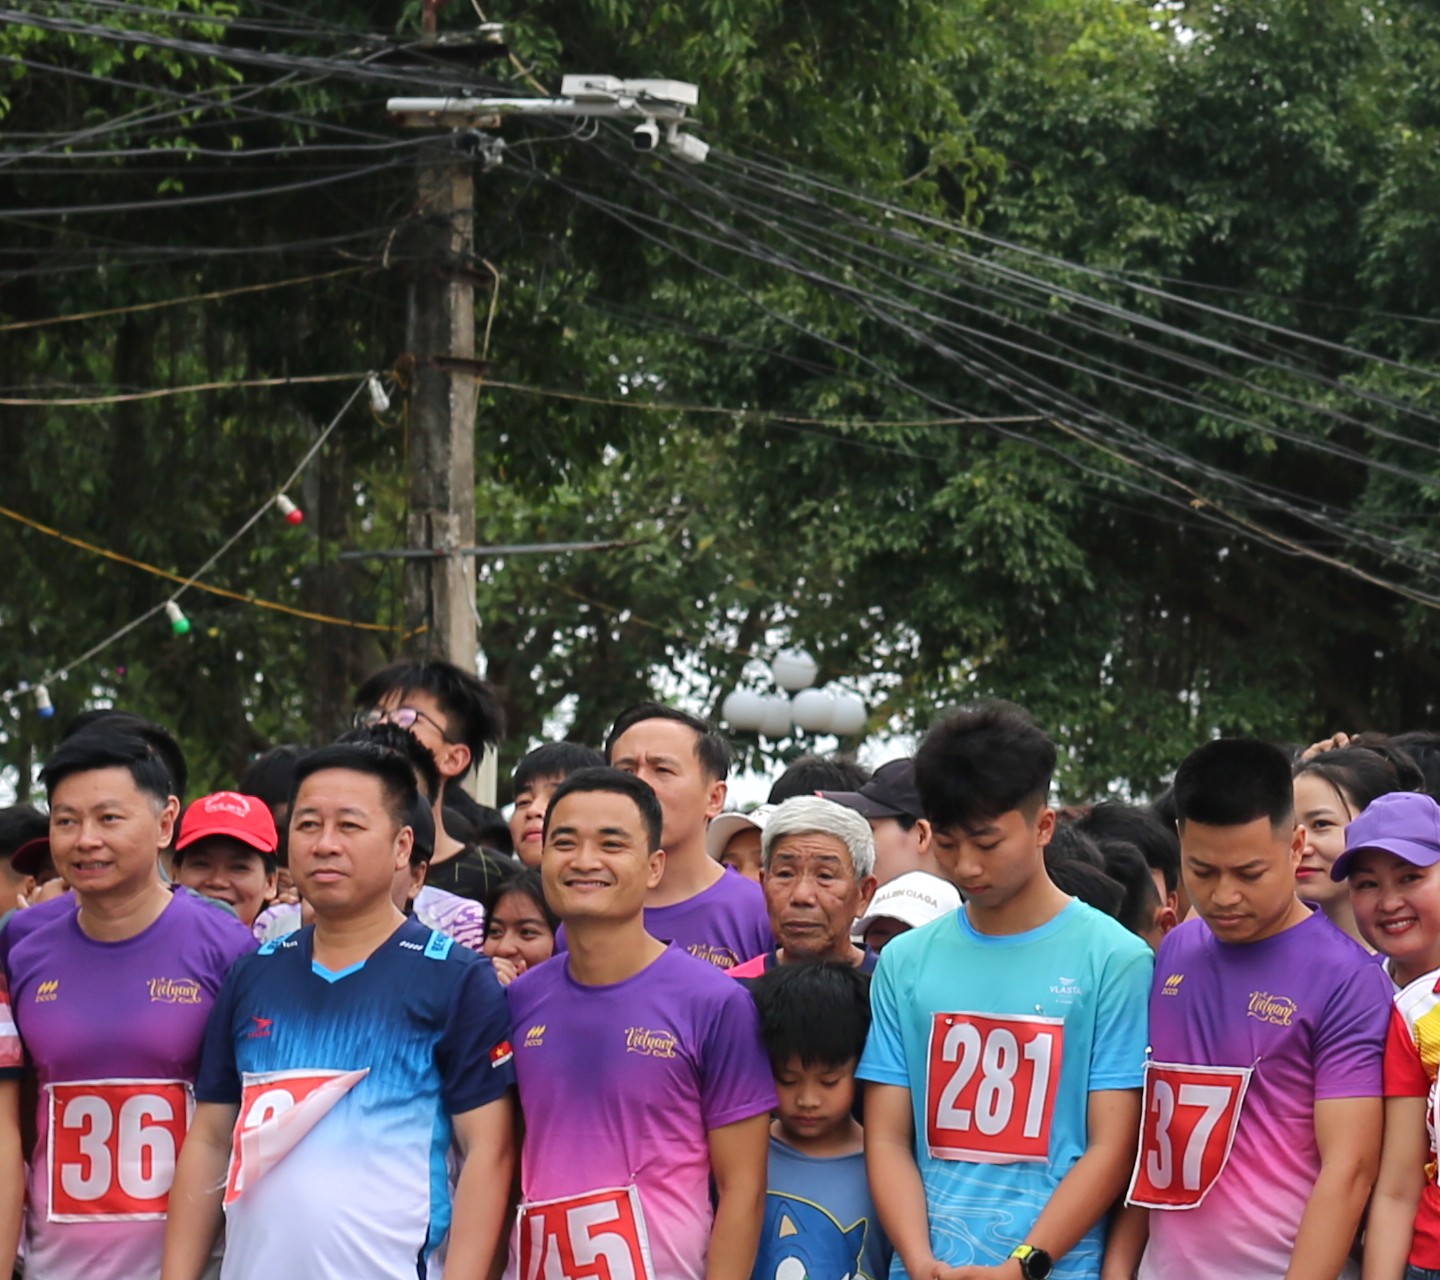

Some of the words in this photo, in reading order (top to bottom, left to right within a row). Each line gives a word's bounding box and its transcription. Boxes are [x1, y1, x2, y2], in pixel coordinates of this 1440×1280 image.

[147, 977, 202, 1004] Vietnam
[1246, 990, 1298, 1026] Vietnam
[624, 1026, 678, 1058] Vietnam
[936, 1023, 1053, 1138] 281
[61, 1095, 176, 1201] 36
[1146, 1080, 1232, 1191] 37
